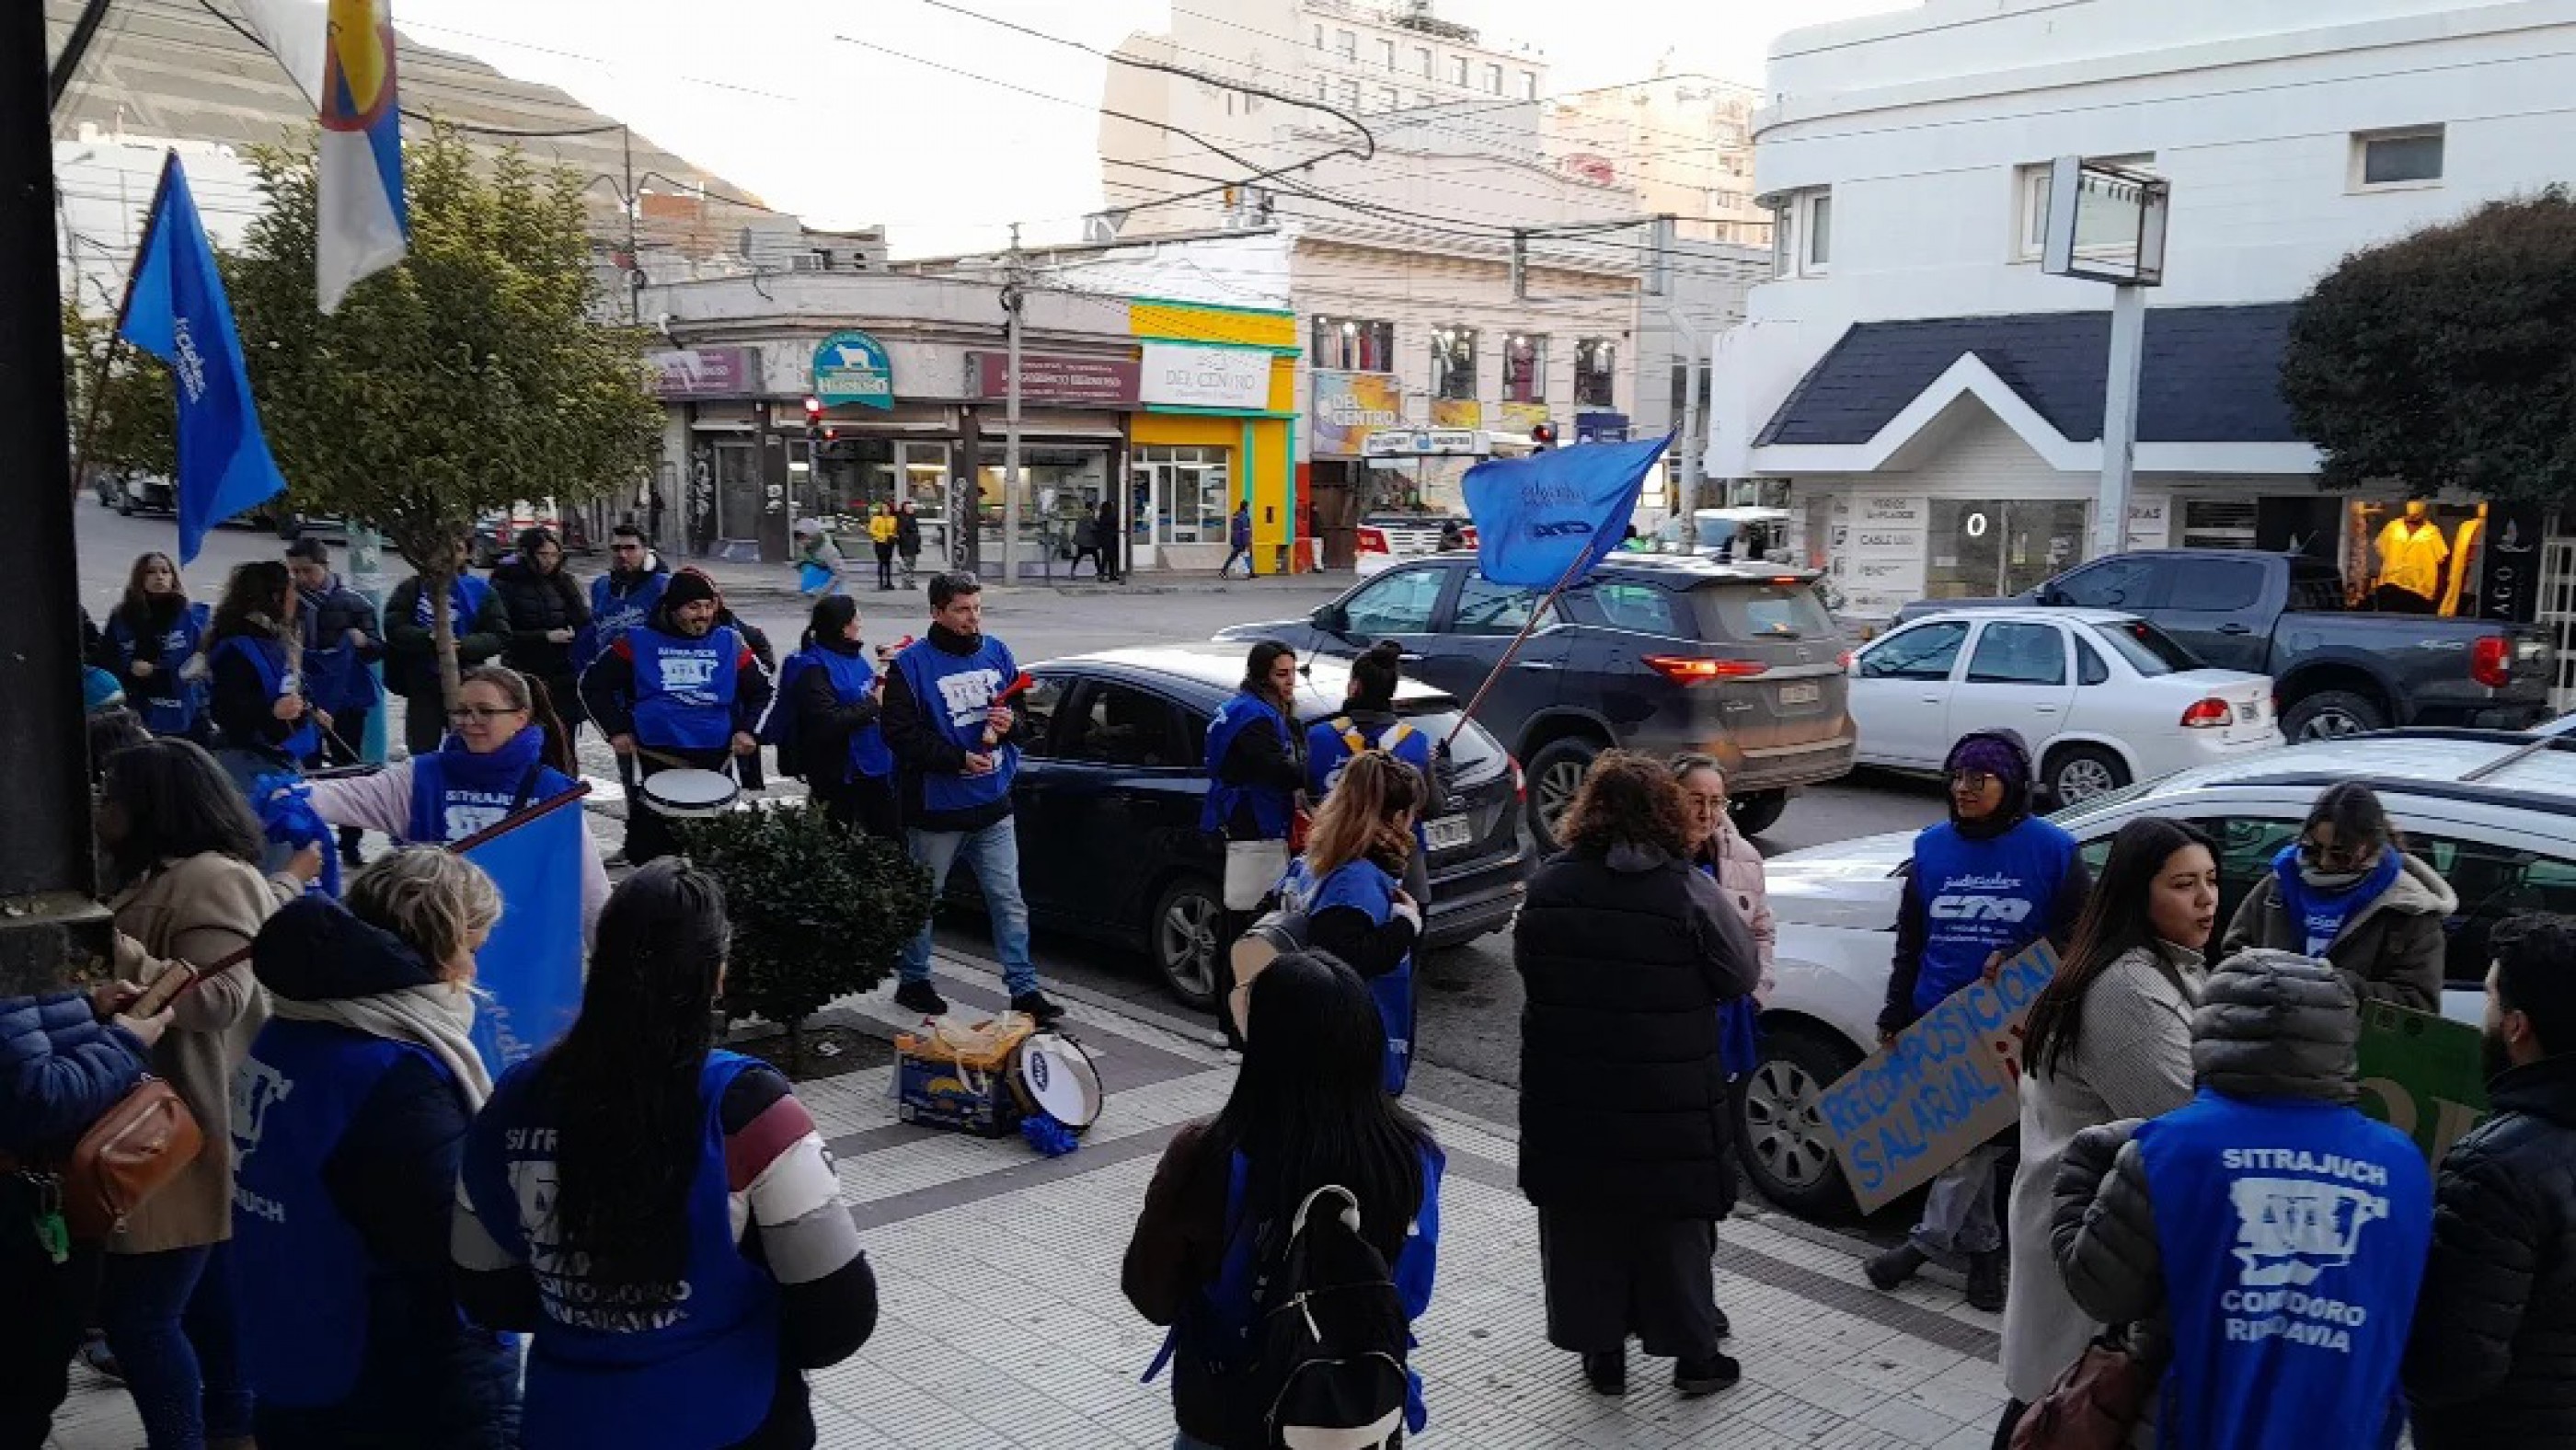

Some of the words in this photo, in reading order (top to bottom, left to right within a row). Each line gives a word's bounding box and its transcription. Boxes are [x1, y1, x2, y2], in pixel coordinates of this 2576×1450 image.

[1332, 394, 1358, 409] DEL
[1333, 410, 1395, 427] CENTRO
[1851, 1058, 2000, 1192] SALARIAL
[2222, 1148, 2388, 1186] SITRAJUCH
[2220, 1289, 2367, 1328] COMDORO
